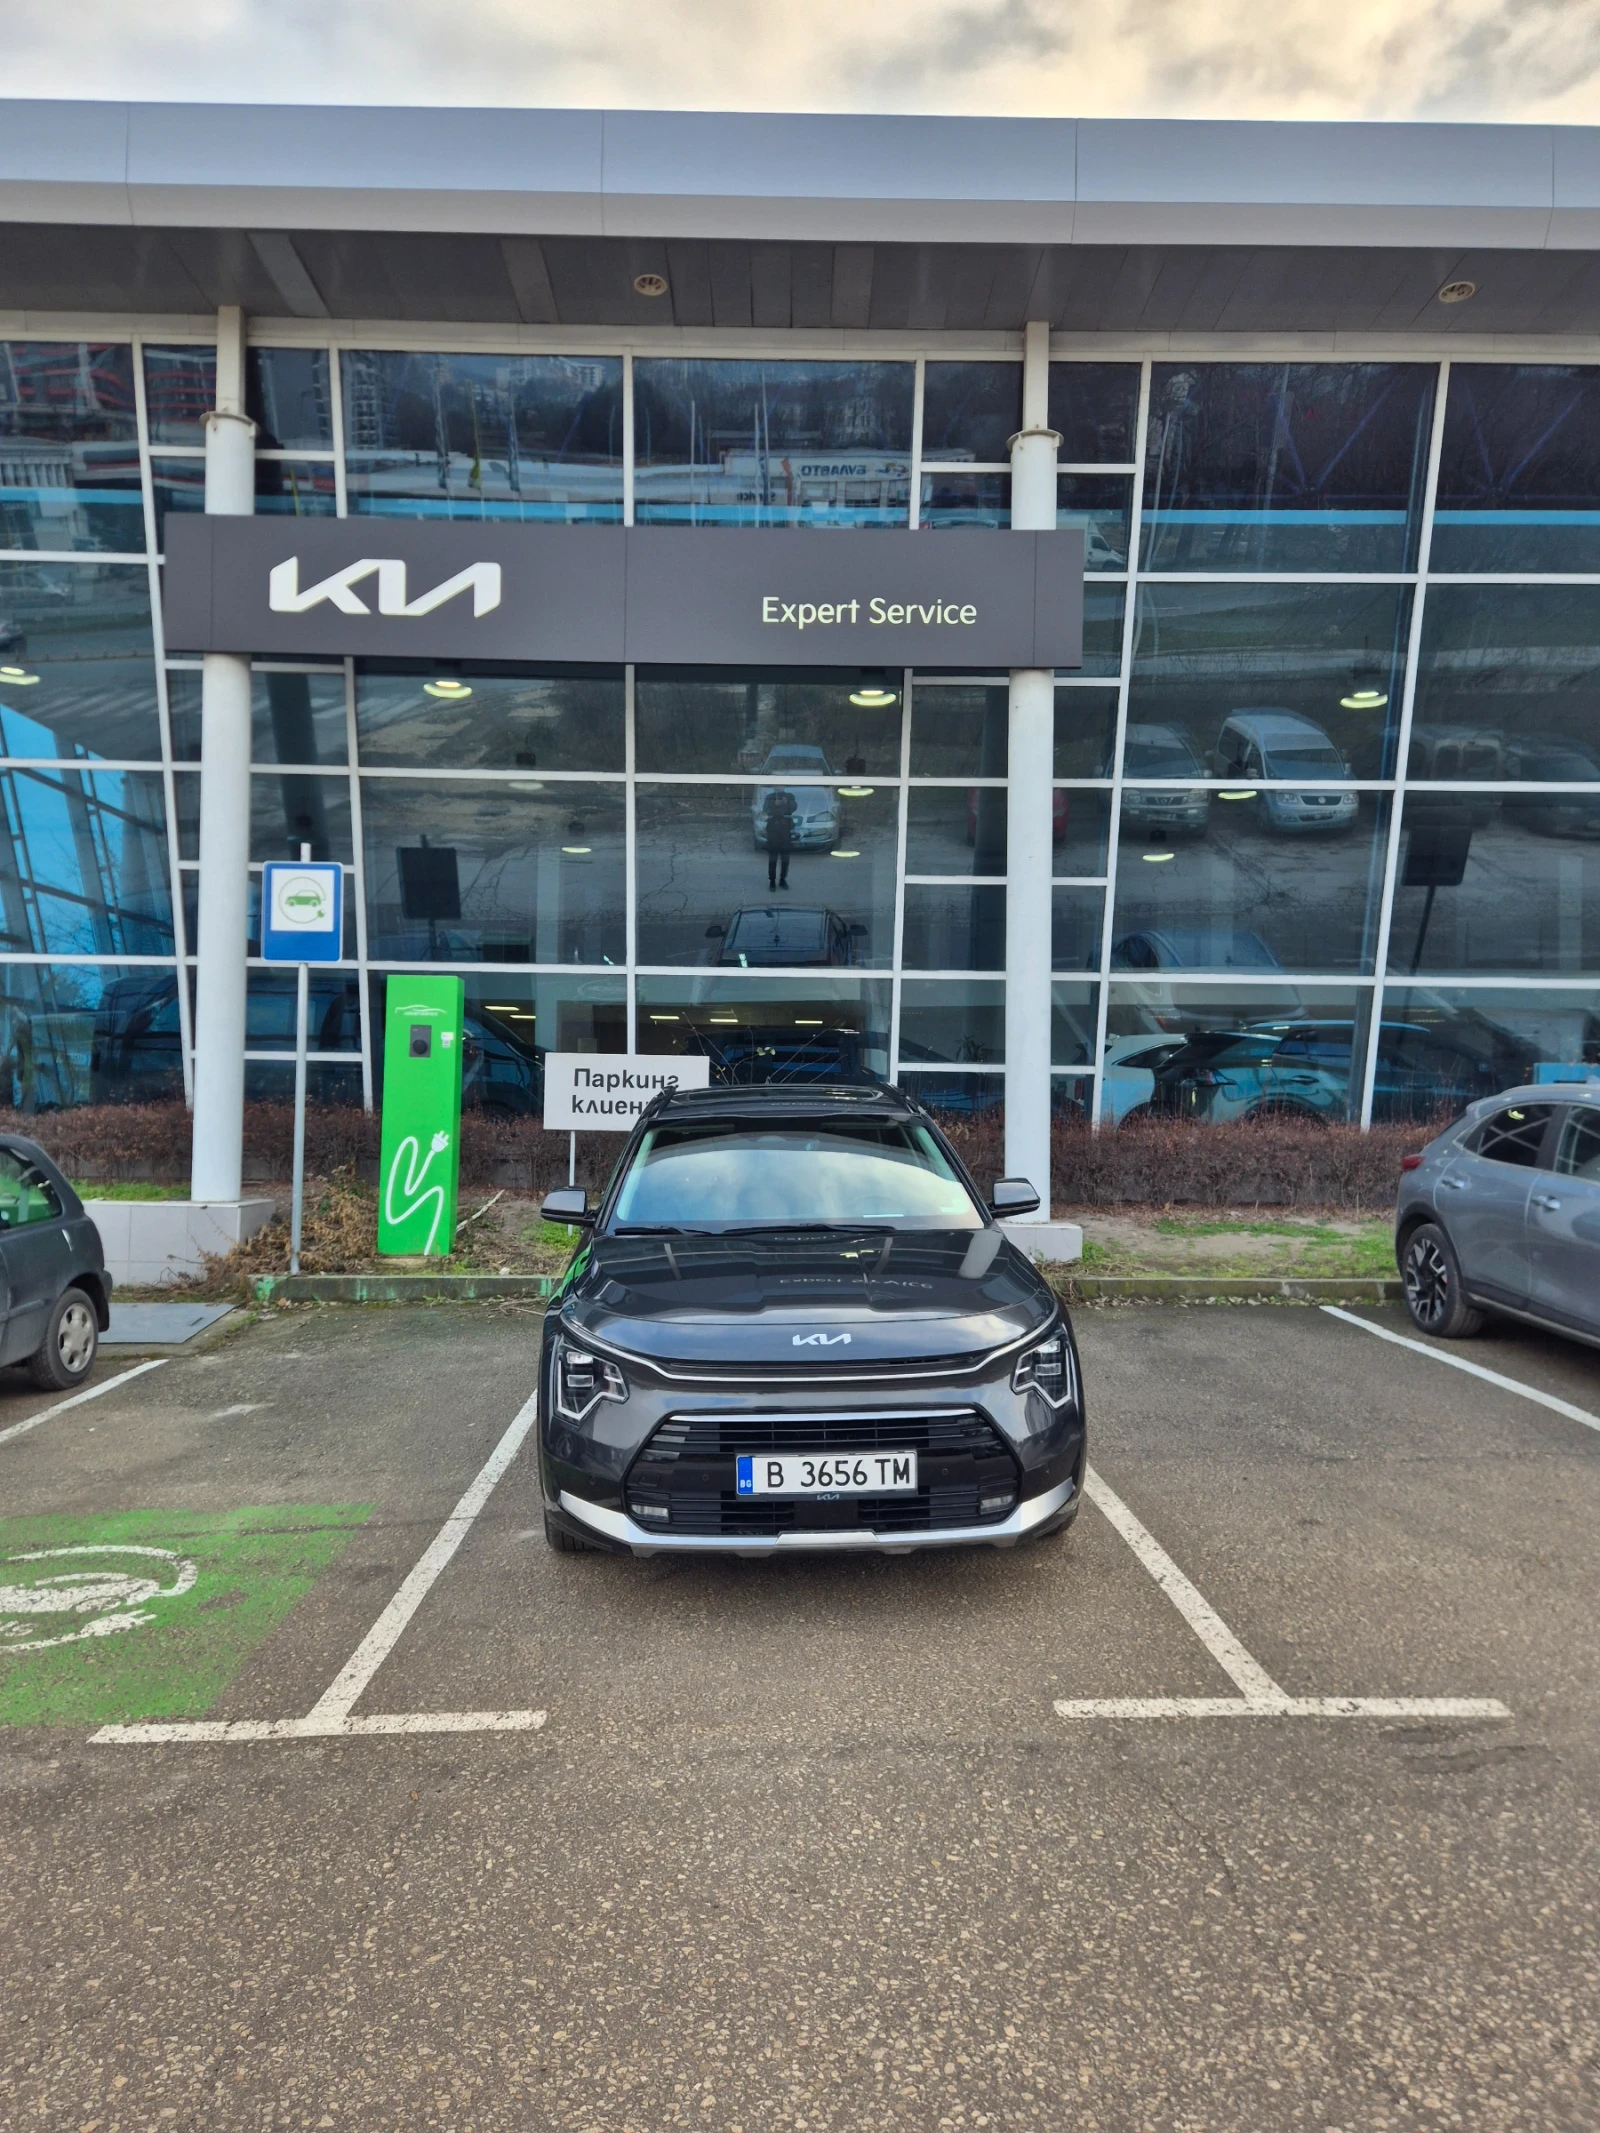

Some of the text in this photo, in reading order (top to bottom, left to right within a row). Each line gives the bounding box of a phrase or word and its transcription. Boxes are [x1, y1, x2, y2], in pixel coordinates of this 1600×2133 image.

[269, 555, 502, 619] KIA
[762, 596, 977, 630] Expert Service
[574, 1068, 679, 1093] Паркинг
[572, 1094, 650, 1115] клиен
[792, 1333, 852, 1346] KIA
[739, 1457, 911, 1489] BG B 3656 TM
[816, 1493, 840, 1501] KIA
